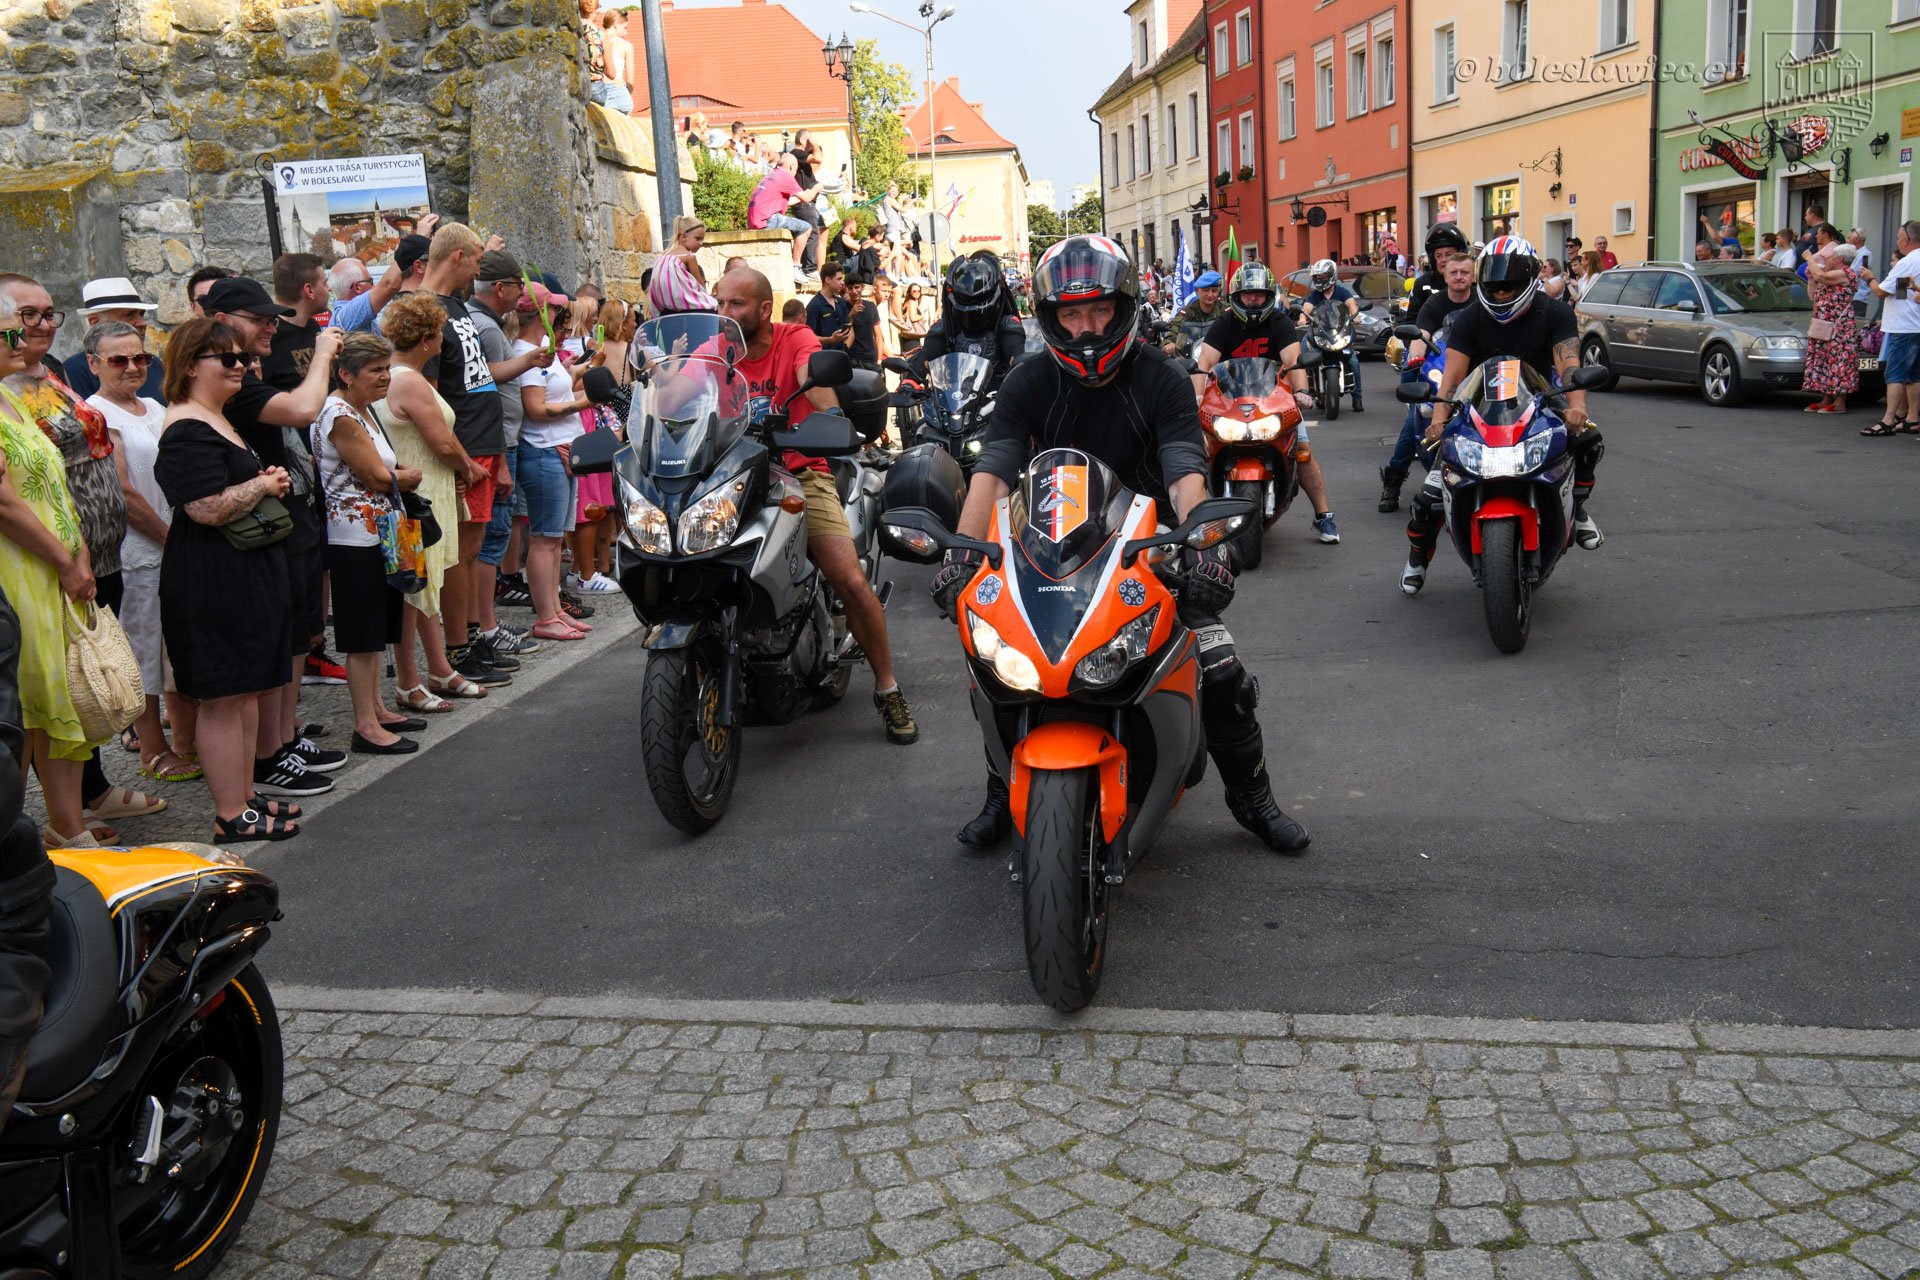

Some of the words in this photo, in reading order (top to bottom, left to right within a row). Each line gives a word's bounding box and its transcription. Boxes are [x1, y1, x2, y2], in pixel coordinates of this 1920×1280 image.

[300, 165, 334, 175] MIEJSKA
[335, 162, 362, 172] TRASA
[362, 159, 421, 171] TURYSTYCZNA
[1717, 145, 1758, 179] CUKIERNIA
[301, 178, 310, 186] W
[311, 174, 366, 186] BOLESŁAWCU
[1231, 337, 1269, 358] 4F
